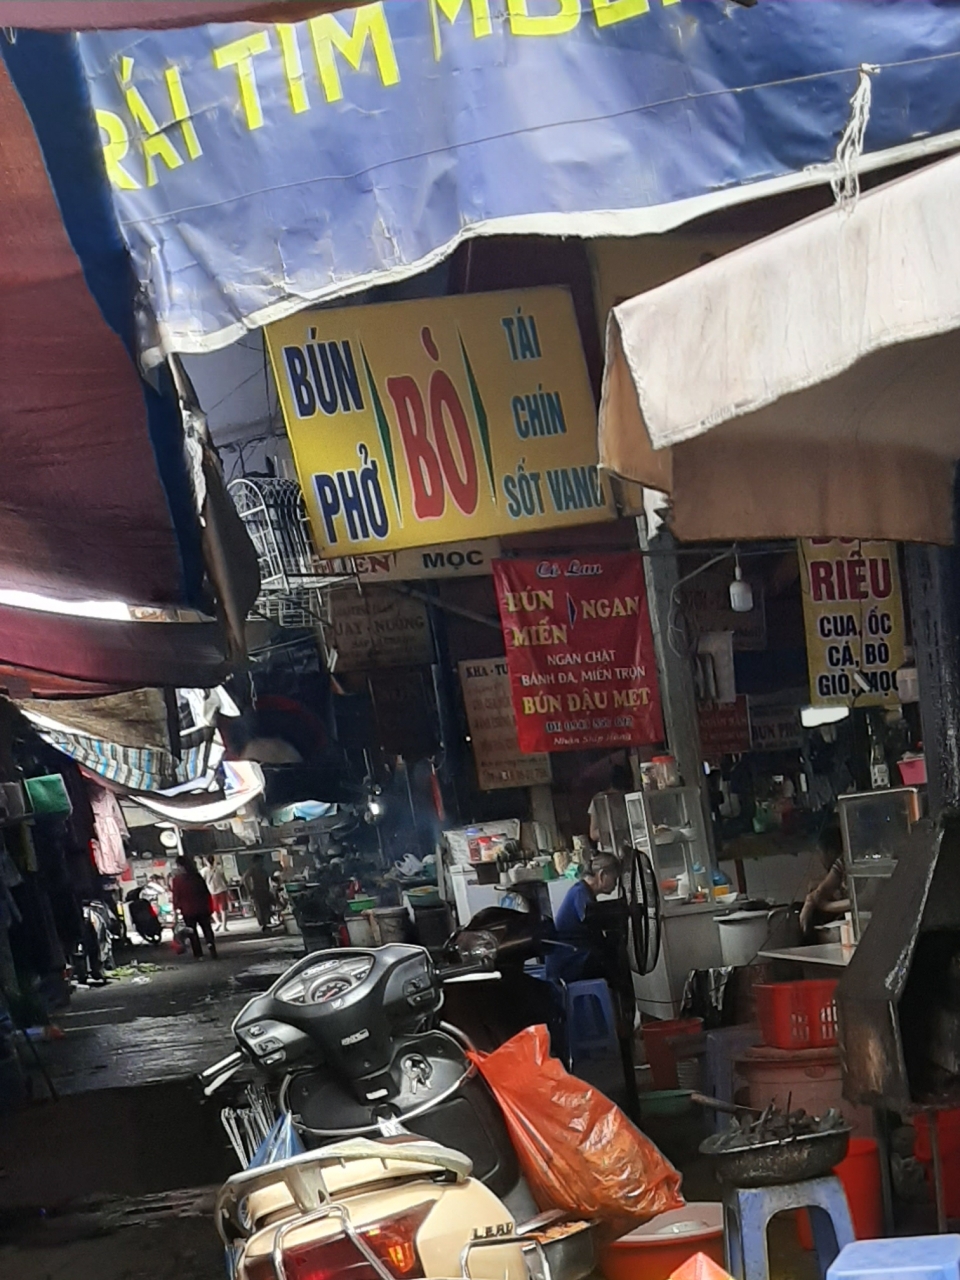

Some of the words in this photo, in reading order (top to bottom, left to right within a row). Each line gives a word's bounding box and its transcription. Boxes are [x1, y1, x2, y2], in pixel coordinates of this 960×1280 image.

[213, 1, 400, 131] TIM
[502, 307, 542, 361] TÁI
[282, 326, 364, 418] BÚN
[385, 325, 479, 521] BÒ
[511, 383, 567, 440] CHÍN
[312, 442, 389, 544] PHỞ
[503, 456, 545, 519] SỐT
[546, 464, 606, 514] VANG
[422, 550, 484, 573] MỌC
[810, 550, 892, 601] RIÊU
[506, 585, 554, 613] BÚN
[580, 596, 639, 619] NGAN
[868, 606, 892, 635] ỐC
[547, 653, 582, 666] NGAN
[865, 637, 889, 665] BÒ
[522, 690, 562, 714] BÚN
[567, 687, 608, 715] ĐẬU
[613, 687, 650, 712] MẸT
